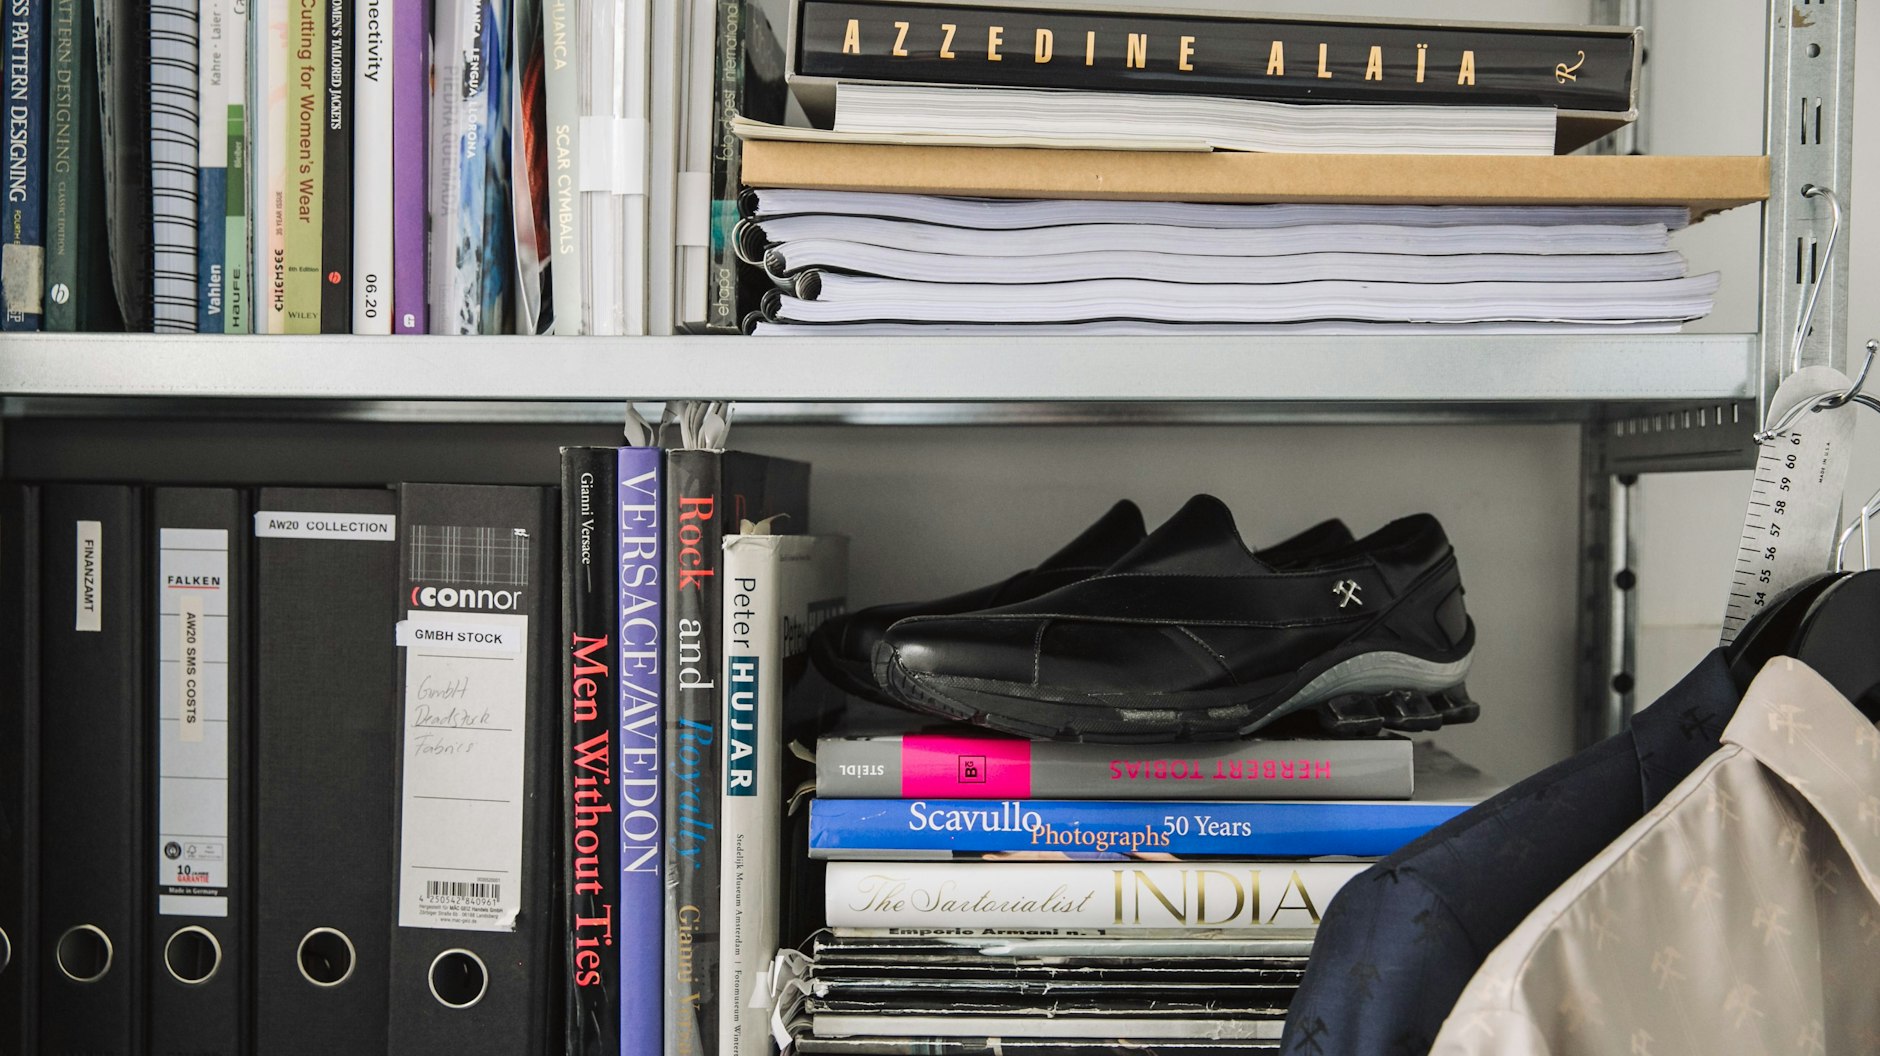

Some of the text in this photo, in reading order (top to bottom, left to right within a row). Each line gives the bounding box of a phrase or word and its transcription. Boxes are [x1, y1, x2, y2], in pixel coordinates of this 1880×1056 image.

[12, 21, 29, 101] PATTERN
[210, 9, 221, 87] Kahre Laier
[330, 39, 343, 88] TAILORED
[722, 2, 740, 83] international
[842, 18, 1476, 86] AZZEDINE ALAÏA
[469, 48, 481, 97] LENGUA
[55, 70, 71, 173] DESIGNING
[297, 0, 316, 223] Cutting for Women's Wear
[328, 88, 342, 130] JACKETS
[466, 101, 479, 160] LLORONA
[9, 105, 28, 203] DESIGNING
[556, 124, 570, 171] SCAR
[57, 218, 66, 256] EDITION
[557, 174, 574, 255] CYMBALS
[208, 264, 222, 316] Vahlen
[274, 249, 284, 313] CHIEMSEE
[365, 274, 378, 319] 06.20
[711, 268, 731, 317] ehapa
[288, 311, 319, 319] WILEY
[1785, 454, 1797, 470] 60
[1790, 432, 1802, 446] 61
[1822, 458, 1827, 466] IN
[1775, 500, 1786, 515] 58
[1780, 476, 1792, 492] 59
[268, 518, 388, 533] AW20 COLLECTION
[580, 472, 595, 565] Gianni Versace
[1769, 523, 1781, 538] 57
[84, 539, 94, 612] FINANZAMT
[1760, 569, 1772, 584] 55
[1765, 546, 1777, 561] 56
[168, 575, 220, 586] FALKEN
[1754, 591, 1767, 606] 54
[414, 629, 503, 645] GMBH STOCK
[186, 612, 196, 724] AW20 SMS COSTS
[417, 674, 469, 701] GmbH
[621, 466, 659, 876] VERSACE/AVEDON
[669, 494, 715, 870] Rock and Royalty
[730, 577, 756, 789] Peter HUJAR
[413, 733, 475, 757] Fabrics
[1108, 759, 1332, 781] HERBERT TOBIAS
[573, 632, 613, 987] Men Without Ties
[909, 801, 1252, 852] Scavullo Photographs 50 Years
[177, 864, 191, 876] 10
[735, 834, 745, 870] Stedelijk
[169, 887, 185, 895] Made
[193, 888, 218, 896] Germany
[176, 875, 209, 884] GARANTIE
[429, 895, 461, 905] 250542
[465, 897, 497, 907] 840961
[735, 872, 744, 907] Museum
[848, 868, 1322, 926] The Sartorialist INDIA
[678, 904, 700, 984] Gianni
[734, 909, 743, 956] Amsterdam
[888, 927, 975, 937] Emporio
[981, 928, 1059, 936] Armani
[734, 970, 743, 1022] Fotomuseum
